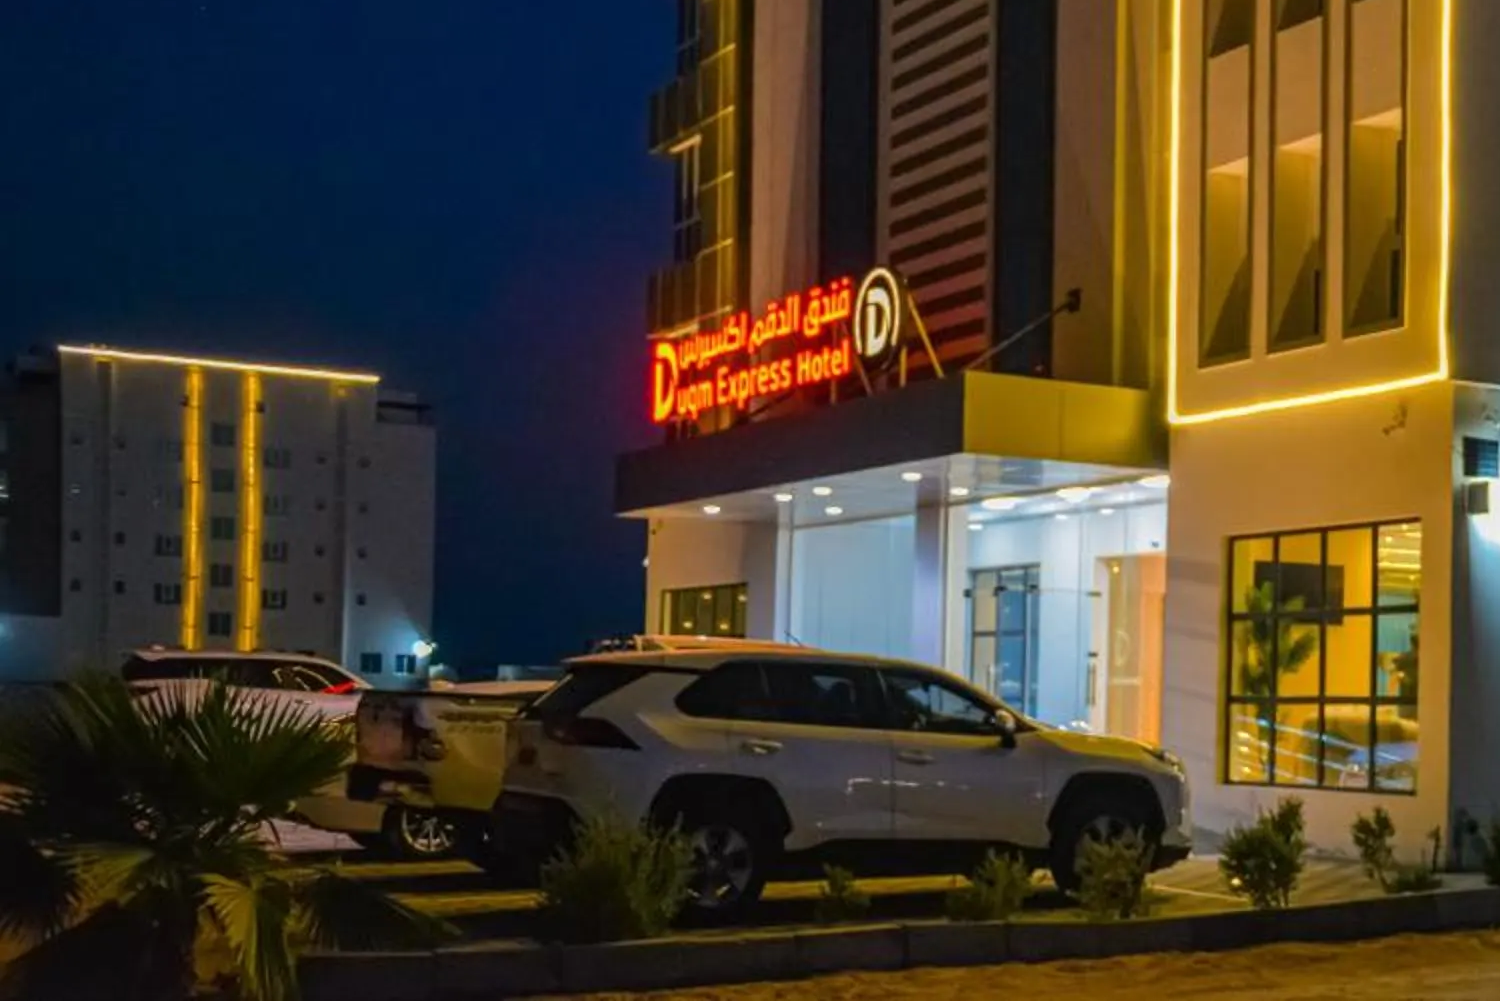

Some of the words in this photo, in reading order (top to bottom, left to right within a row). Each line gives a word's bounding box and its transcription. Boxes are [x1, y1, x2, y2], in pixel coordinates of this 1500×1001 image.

[750, 294, 799, 353] الدقم
[803, 277, 850, 335] فندق
[654, 343, 712, 421] Duqm
[717, 360, 791, 409] Express
[797, 340, 850, 385] Hotel
